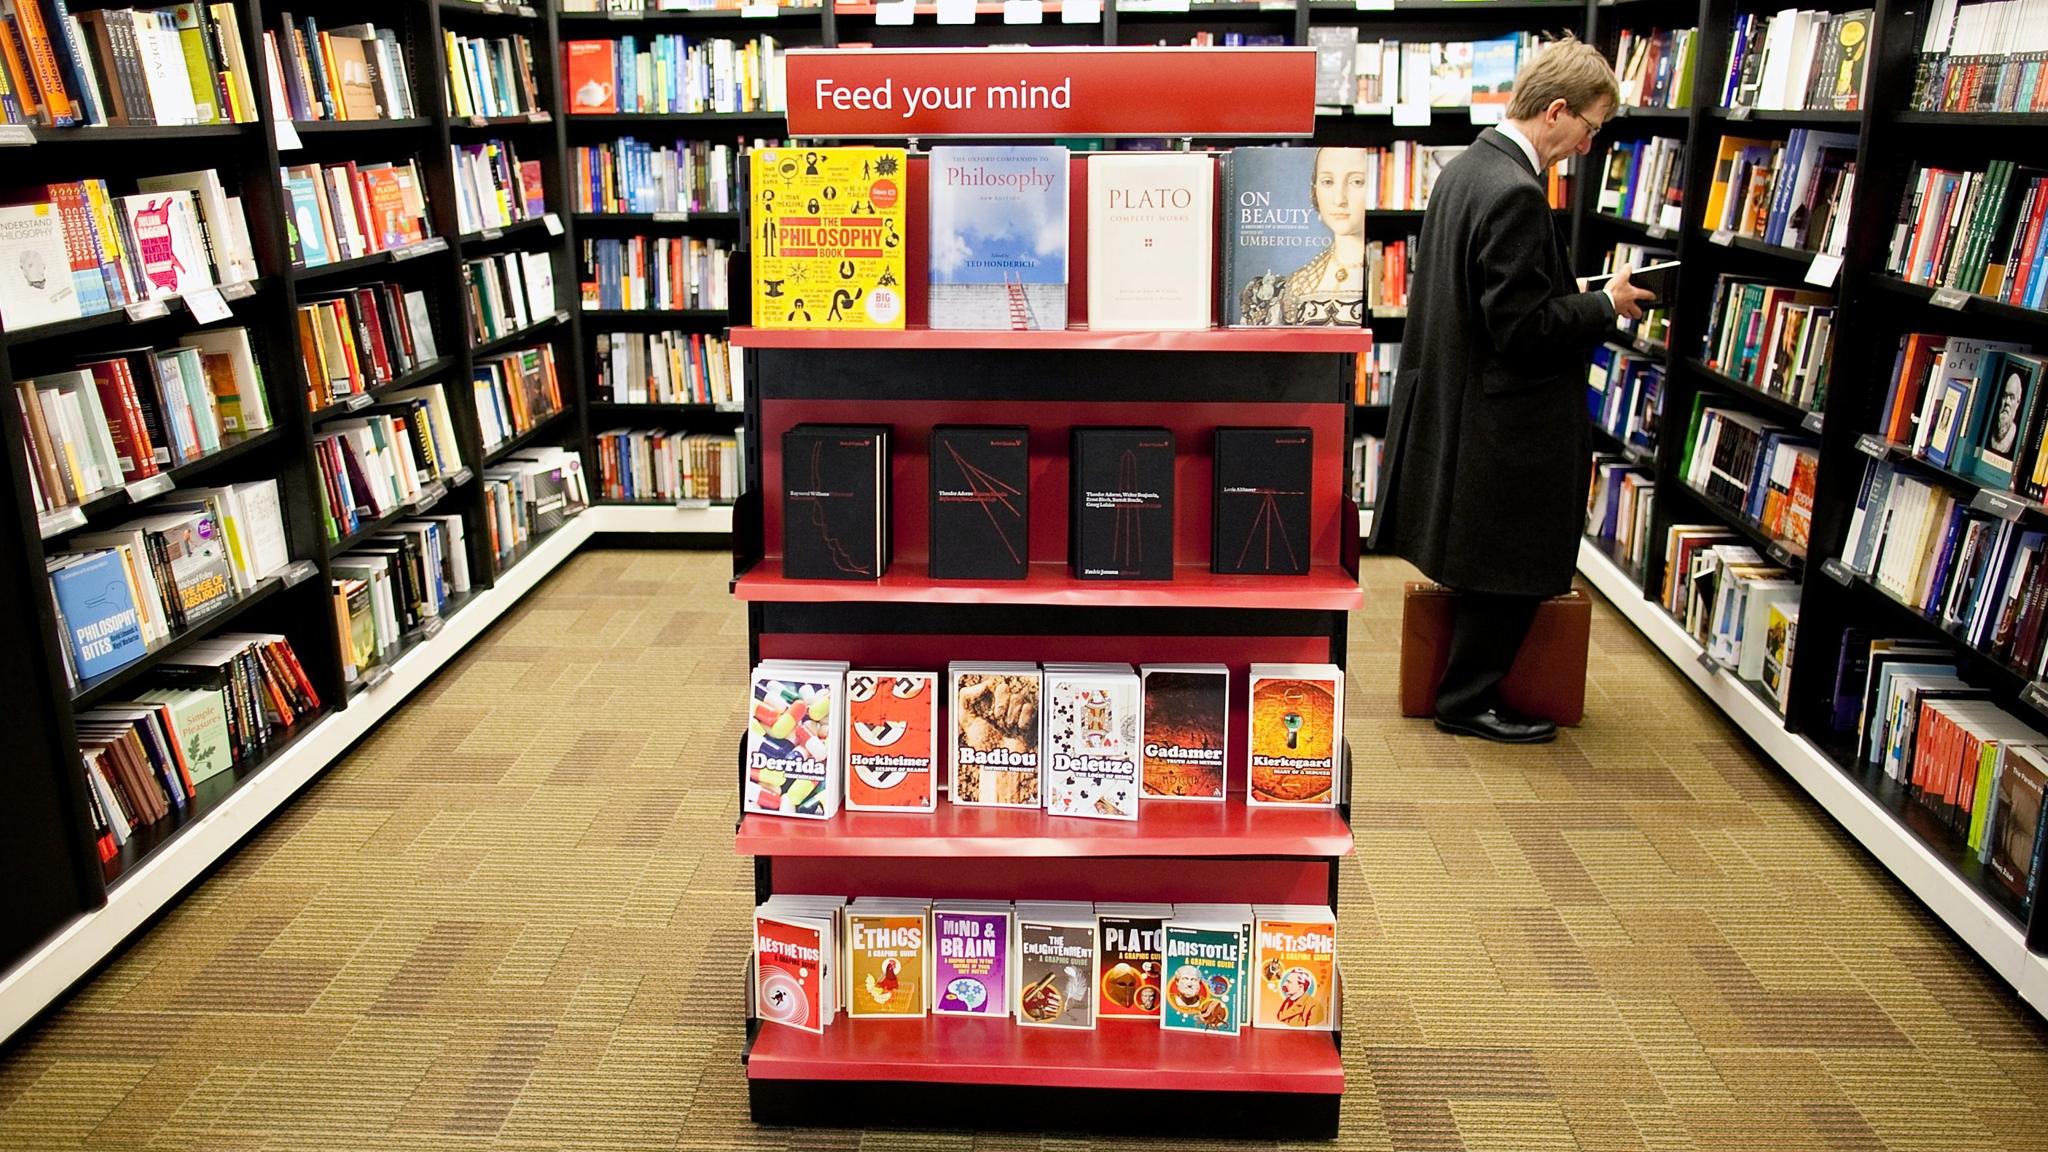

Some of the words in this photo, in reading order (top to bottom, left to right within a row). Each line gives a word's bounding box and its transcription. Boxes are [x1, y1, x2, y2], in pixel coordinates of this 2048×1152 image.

[58, 2, 84, 69] PHILOSOPHY
[31, 36, 54, 94] Philosophy
[42, 36, 63, 94] Philosophy
[148, 36, 165, 79] IDEAS
[815, 78, 892, 110] Feed
[903, 83, 977, 118] your
[987, 77, 1072, 109] mind
[947, 166, 1055, 192] Philosophy
[1109, 188, 1192, 209] PLATO
[1240, 191, 1270, 207] ON
[0, 218, 52, 230] NDERSTAND
[823, 217, 839, 226] THE
[1241, 208, 1312, 224] BEAUTY
[0, 227, 52, 240] HILOSOPHY
[64, 208, 83, 262] CHRISTMAS
[72, 207, 90, 261] CHRISTMAS
[80, 207, 97, 261] CHRISTMAS
[779, 228, 883, 247] PHILOSOPHY
[1240, 236, 1302, 247] UMBERTO
[1306, 236, 1332, 247] ECO
[819, 249, 843, 258] BOOK
[966, 260, 983, 268] TED
[984, 260, 1035, 268] HONDERICH
[876, 293, 891, 302] BIG
[1954, 341, 1981, 355] The
[1949, 360, 1965, 369] of
[180, 586, 196, 598] THE
[197, 579, 212, 592] AGE
[212, 574, 223, 586] OF
[184, 582, 227, 609] ABSURDITY
[76, 608, 136, 645] PHILOSOPHY
[81, 637, 113, 662] BITES
[187, 706, 216, 725] Simple
[182, 715, 222, 738] Pleasures
[851, 754, 929, 767] Horkheimer
[959, 747, 1037, 766] Badiou
[1144, 743, 1223, 760] Gadamer
[751, 752, 826, 775] Derrida
[1053, 753, 1134, 775] Deleuze
[1253, 755, 1331, 769] Kierkegaard
[852, 923, 922, 950] ETHICS
[943, 920, 980, 937] MIND
[984, 923, 996, 938] &
[759, 936, 819, 961] AESTHETICS
[941, 937, 996, 958] BRAIN
[1048, 935, 1065, 946] THE
[1168, 939, 1238, 961] ARISTOTLE
[1261, 932, 1334, 953] NIETZSCHE
[1023, 942, 1093, 959] ENLIGHTENMENT
[1124, 952, 1149, 960] GRAPHIC
[1313, 953, 1331, 961] GUIDE
[779, 956, 800, 966] GRAPHIC
[801, 960, 816, 970] GUIDE
[1044, 956, 1069, 965] GRAPHIC
[1070, 958, 1088, 966] GUIDE
[1185, 957, 1190, 965] A
[1190, 957, 1215, 967] GRAPHIC
[1216, 961, 1235, 969] GUIDE
